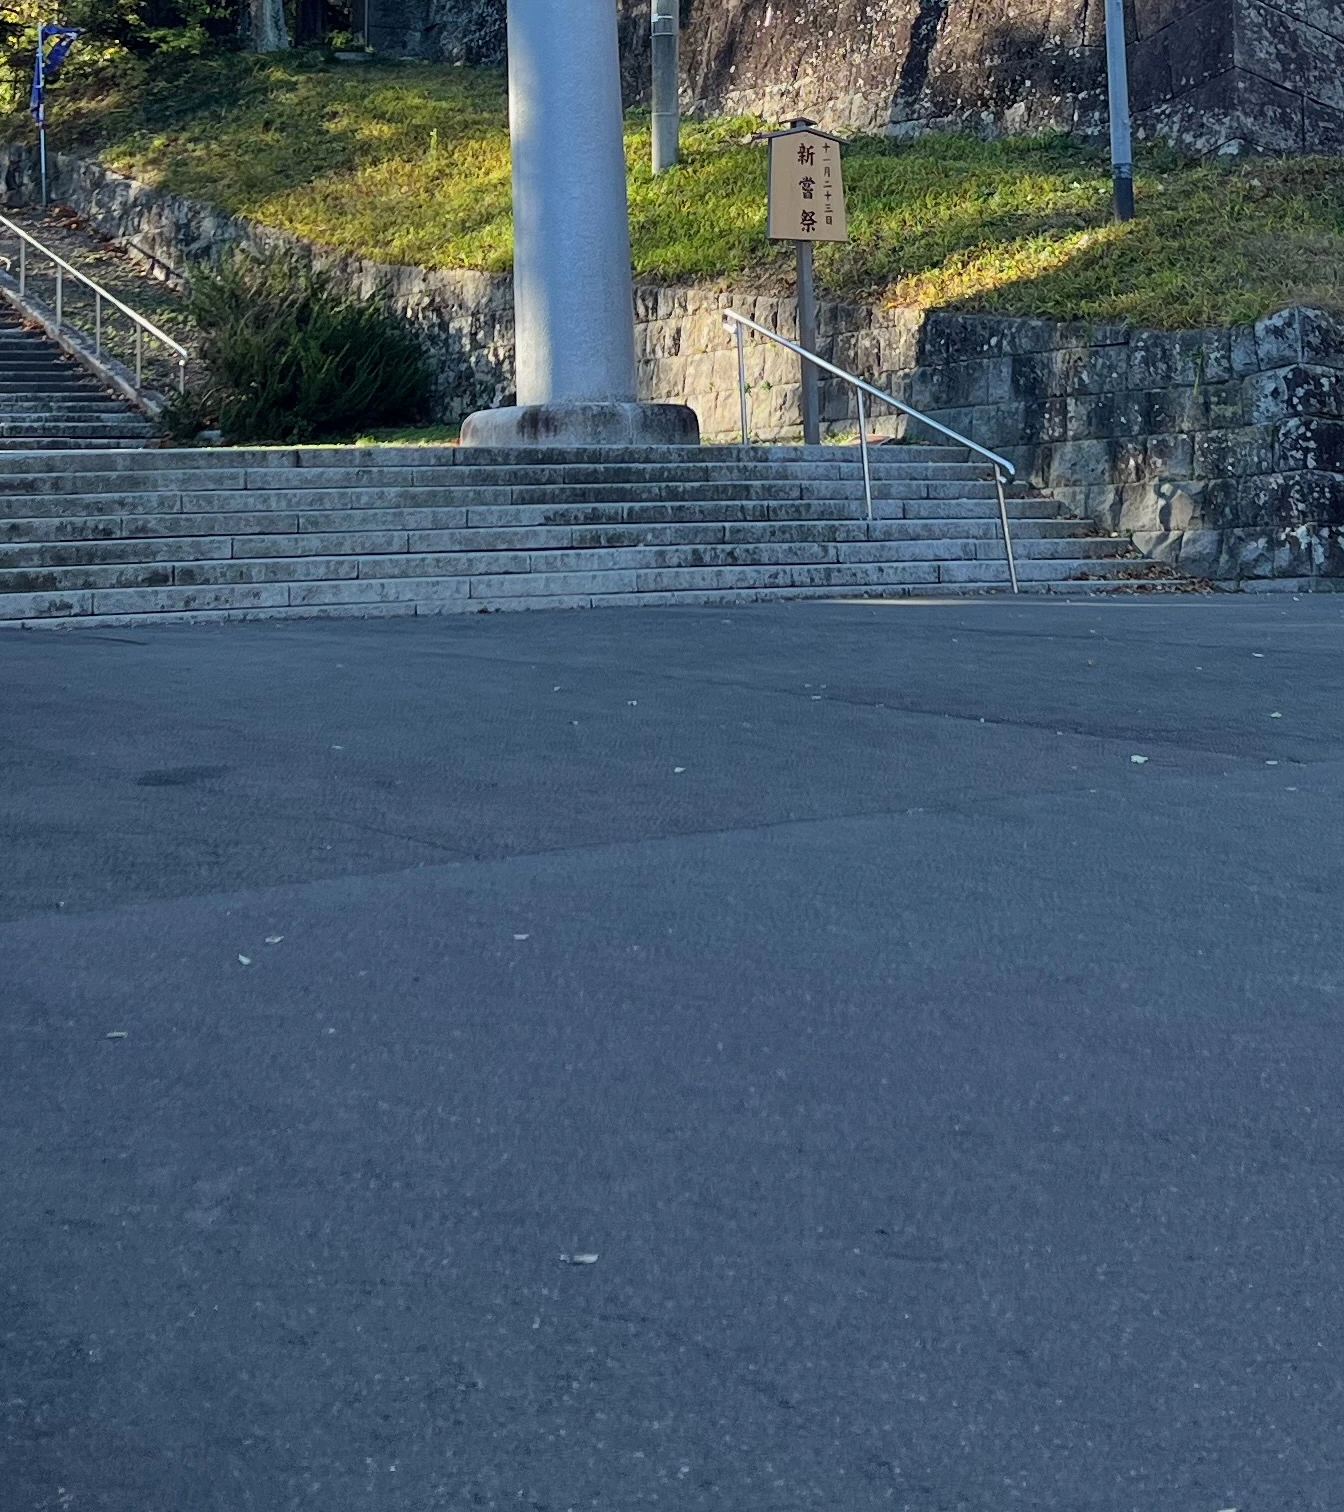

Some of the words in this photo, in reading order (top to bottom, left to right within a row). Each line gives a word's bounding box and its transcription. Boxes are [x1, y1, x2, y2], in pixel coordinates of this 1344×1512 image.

[797, 142, 818, 234] 新嘗祭
[822, 143, 833, 226] 十一月二十三日
